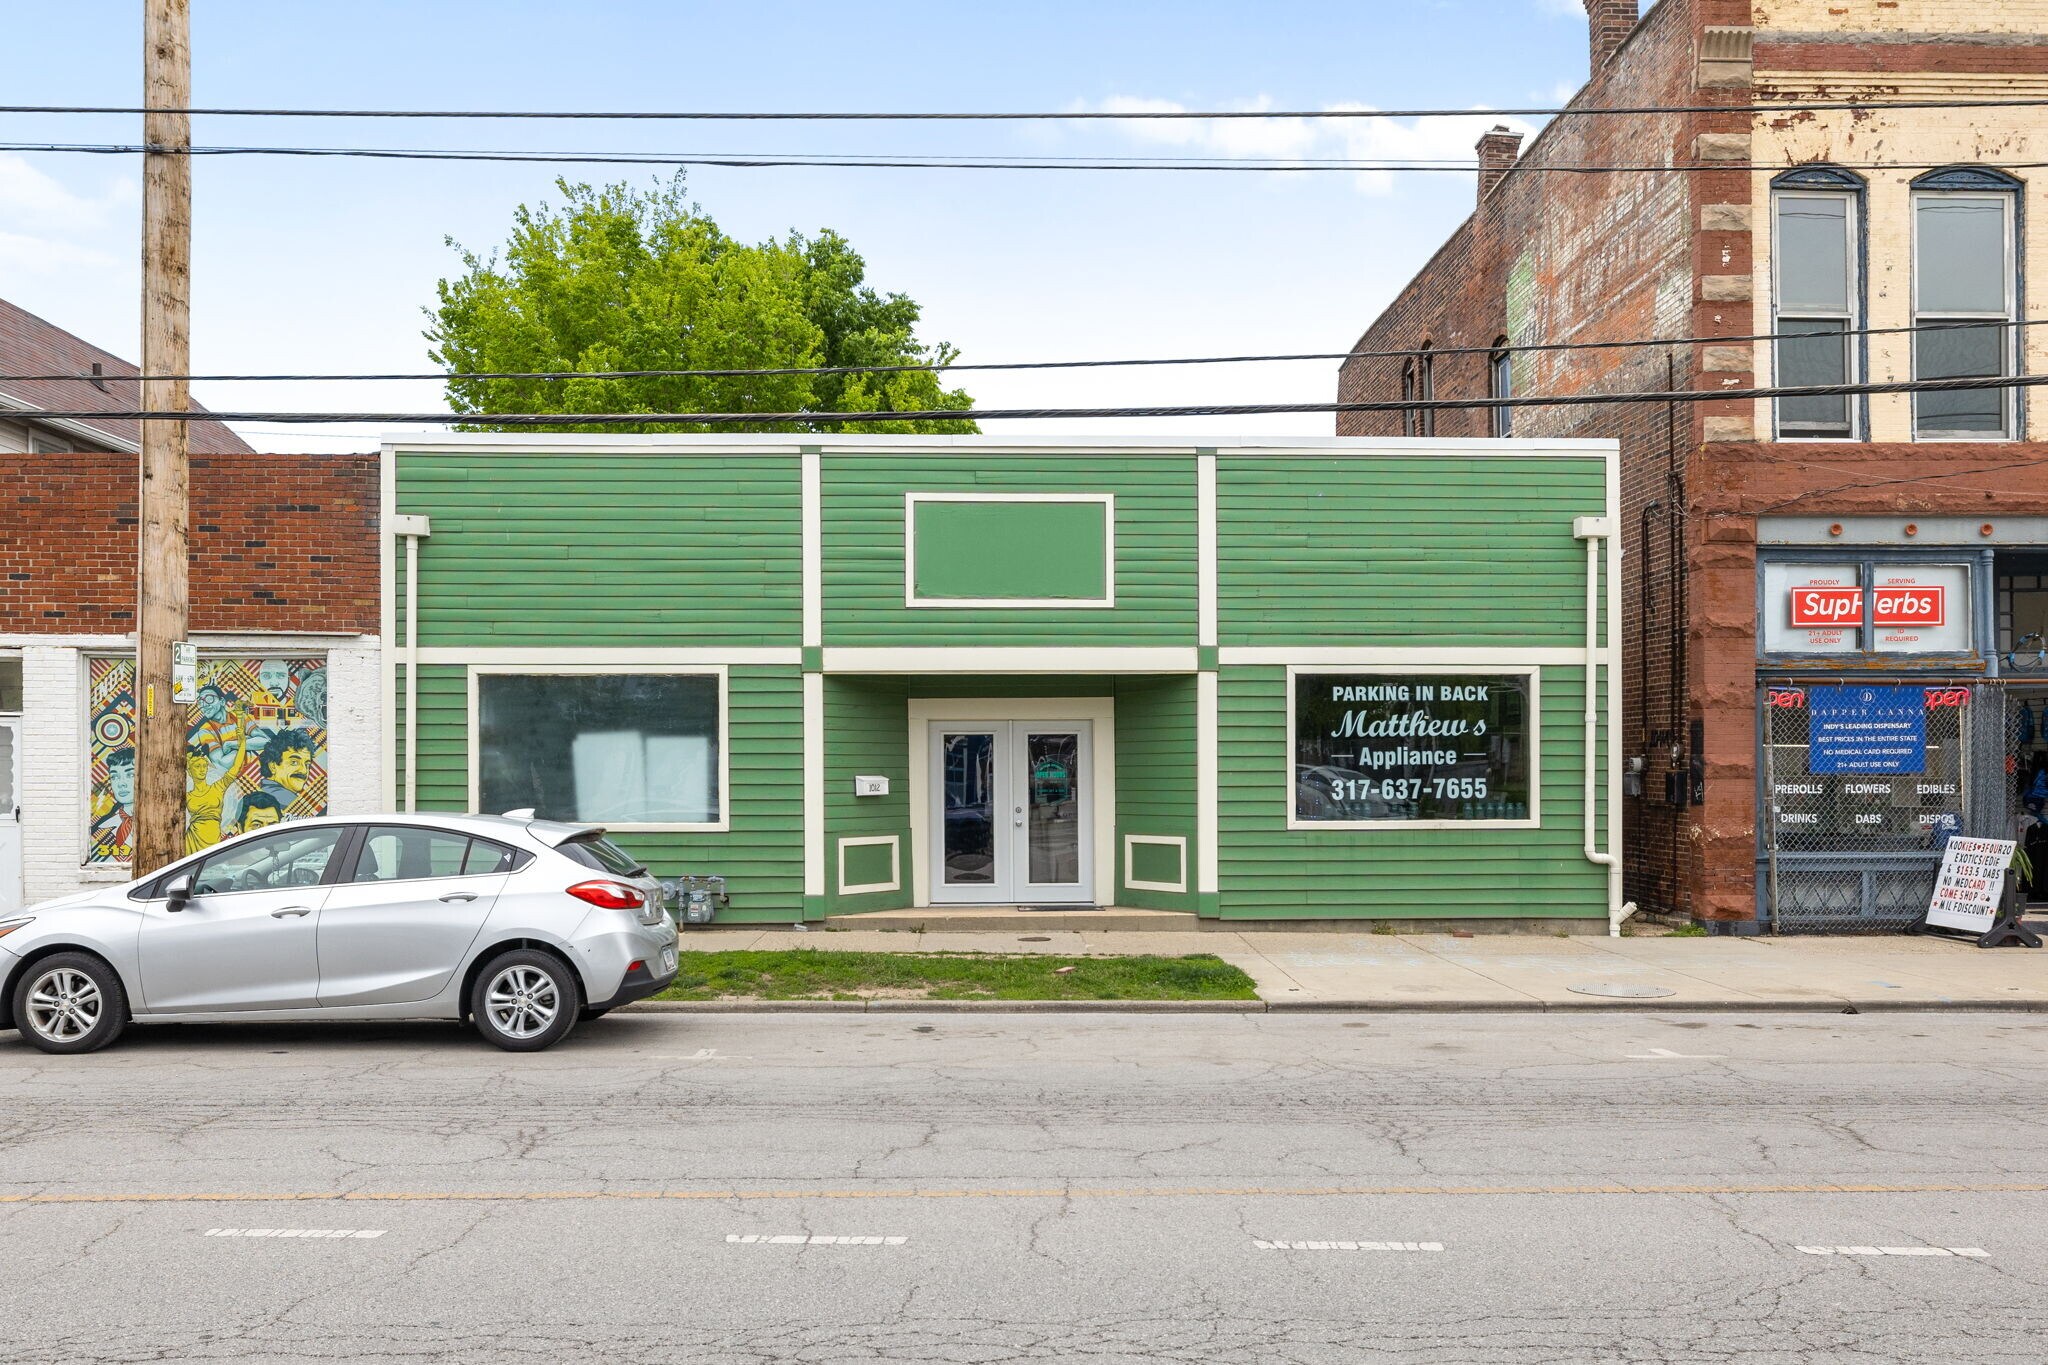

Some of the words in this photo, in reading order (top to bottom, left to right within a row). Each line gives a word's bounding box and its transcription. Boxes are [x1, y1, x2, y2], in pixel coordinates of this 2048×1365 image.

[175, 646, 181, 662] 2
[1332, 685, 1410, 702] PARKING
[1415, 685, 1434, 701] IN
[1440, 685, 1488, 701] BACK
[1811, 708, 1868, 716] DAPPER
[1877, 708, 1924, 716] CANNA
[1359, 746, 1457, 770] Appliance
[1331, 778, 1487, 801] 317-637-7655
[1774, 784, 1823, 794] PREROLLS
[1845, 783, 1891, 794] FLOWERS
[1916, 784, 1956, 794] EDIBLES
[1780, 813, 1818, 823] DRINKS
[1855, 814, 1882, 824] DABS
[97, 844, 131, 856] 317
[1982, 868, 2000, 879] DABS
[1942, 876, 1952, 886] NO
[1940, 888, 1958, 900] COME
[1960, 891, 1979, 901] SHOP
